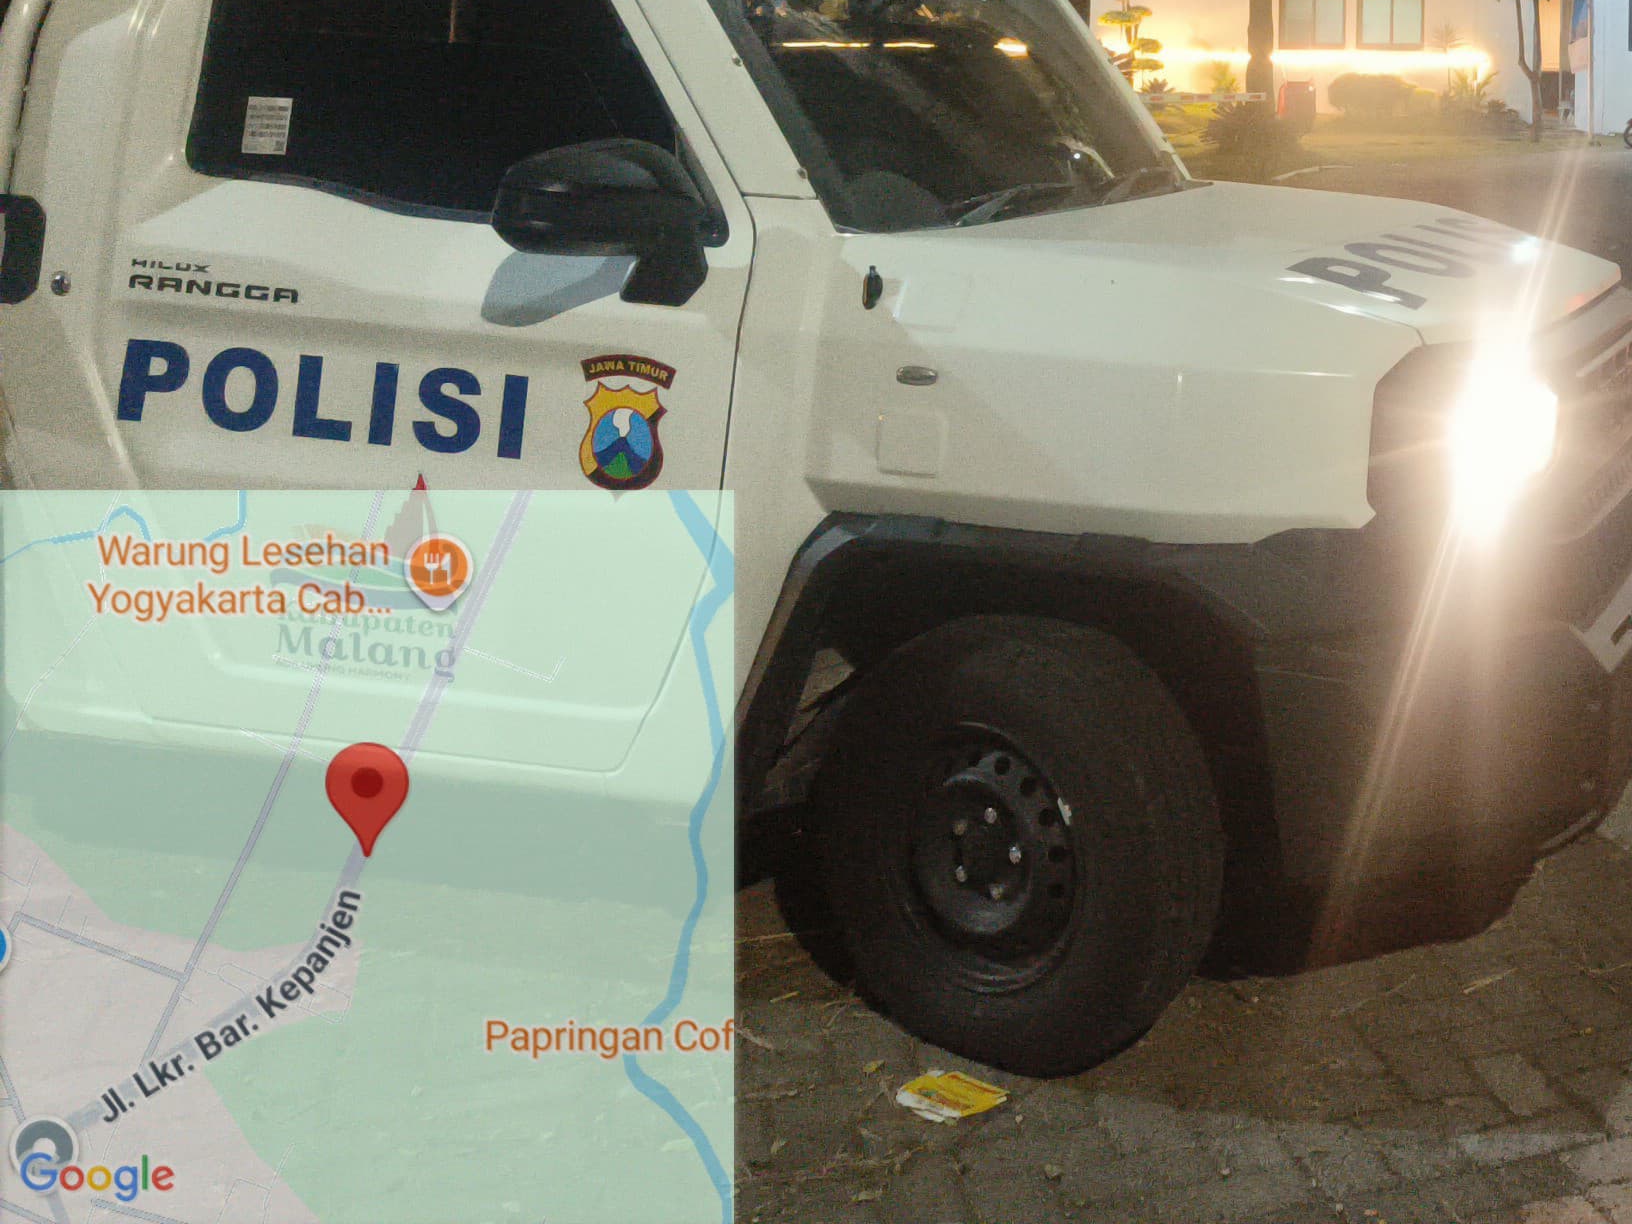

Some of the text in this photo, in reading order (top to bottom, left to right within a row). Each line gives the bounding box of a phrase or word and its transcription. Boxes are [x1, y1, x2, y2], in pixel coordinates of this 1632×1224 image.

[131, 258, 211, 274] HILUX
[128, 274, 299, 304] RANGGA
[589, 359, 669, 382] JAWA TIMUR
[118, 339, 529, 458] POLISI
[275, 623, 455, 683] Malang
